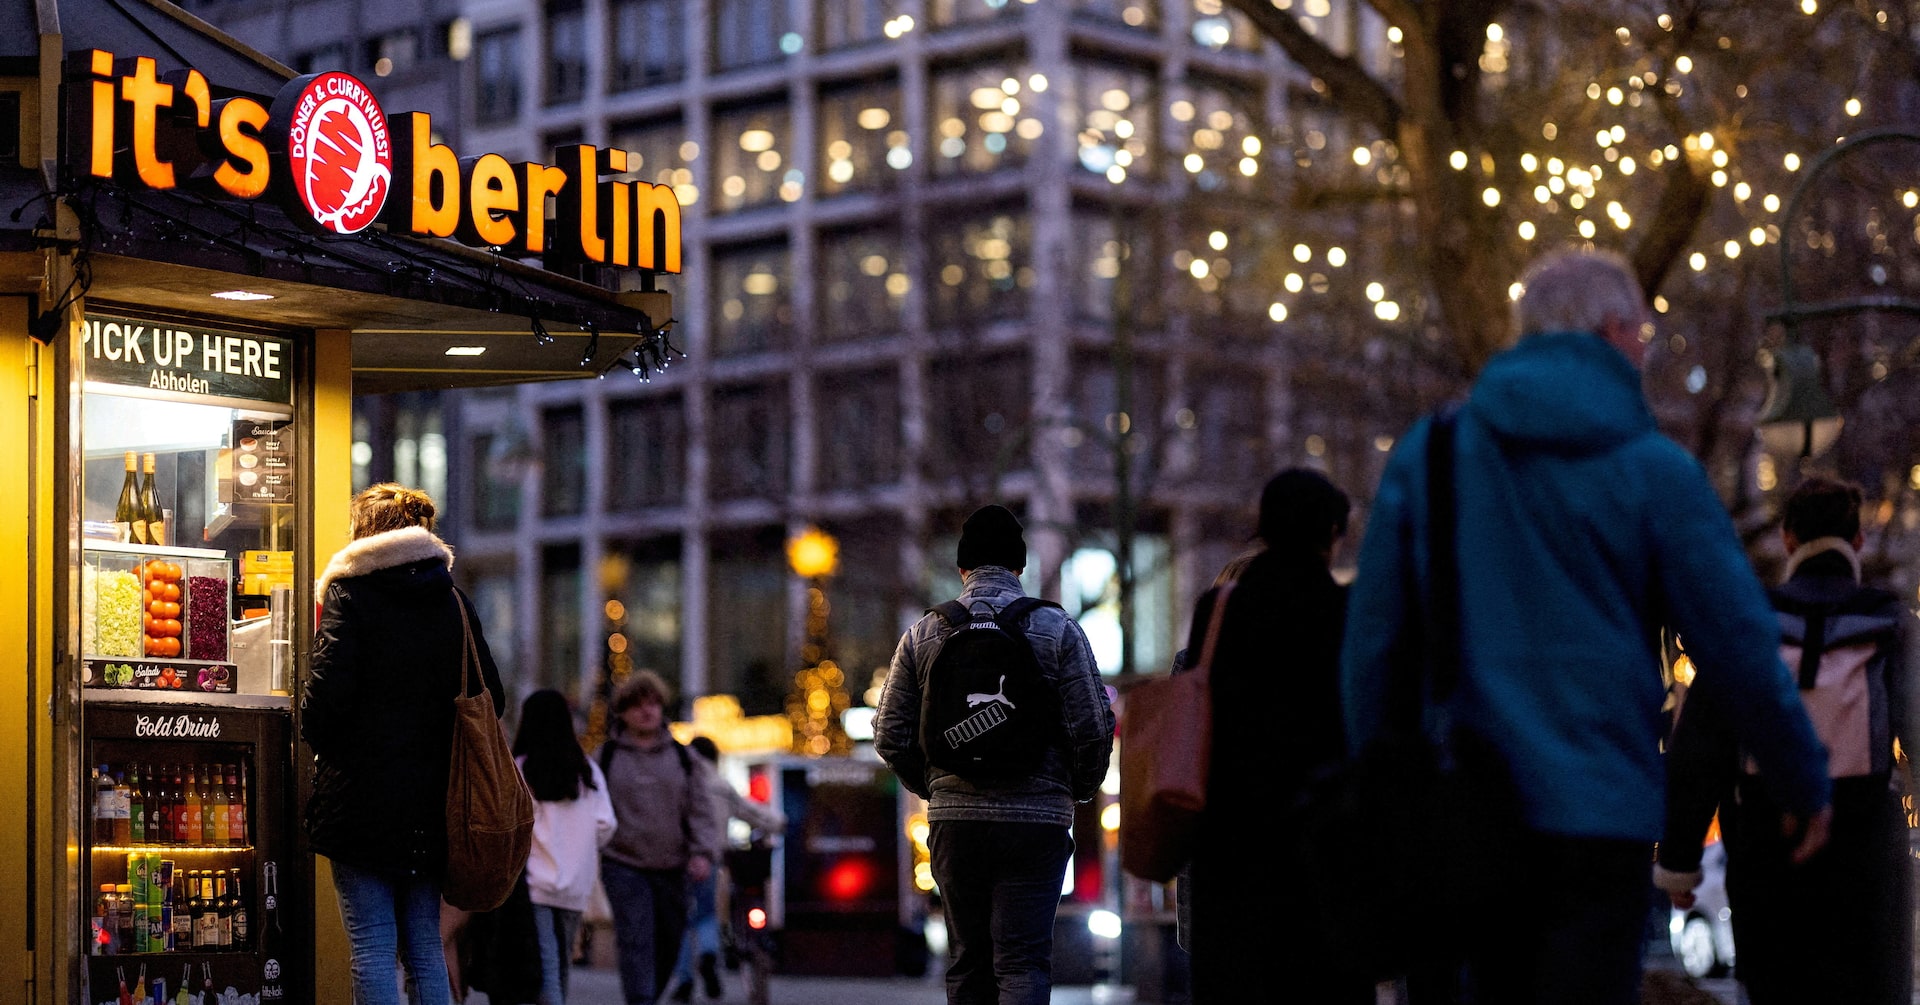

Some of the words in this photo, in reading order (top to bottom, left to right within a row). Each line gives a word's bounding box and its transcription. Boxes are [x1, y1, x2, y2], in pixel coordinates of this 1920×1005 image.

[91, 49, 270, 197] it's
[291, 94, 317, 158] DÖNER
[315, 85, 327, 101] &
[327, 78, 389, 160] CURRYWURST
[412, 111, 682, 275] berlin
[153, 328, 194, 368] UP
[202, 334, 281, 380] HERE
[149, 369, 209, 394] Abholen
[136, 714, 173, 737] Cold
[173, 715, 220, 738] Drink
[944, 702, 1007, 749] PUMA
